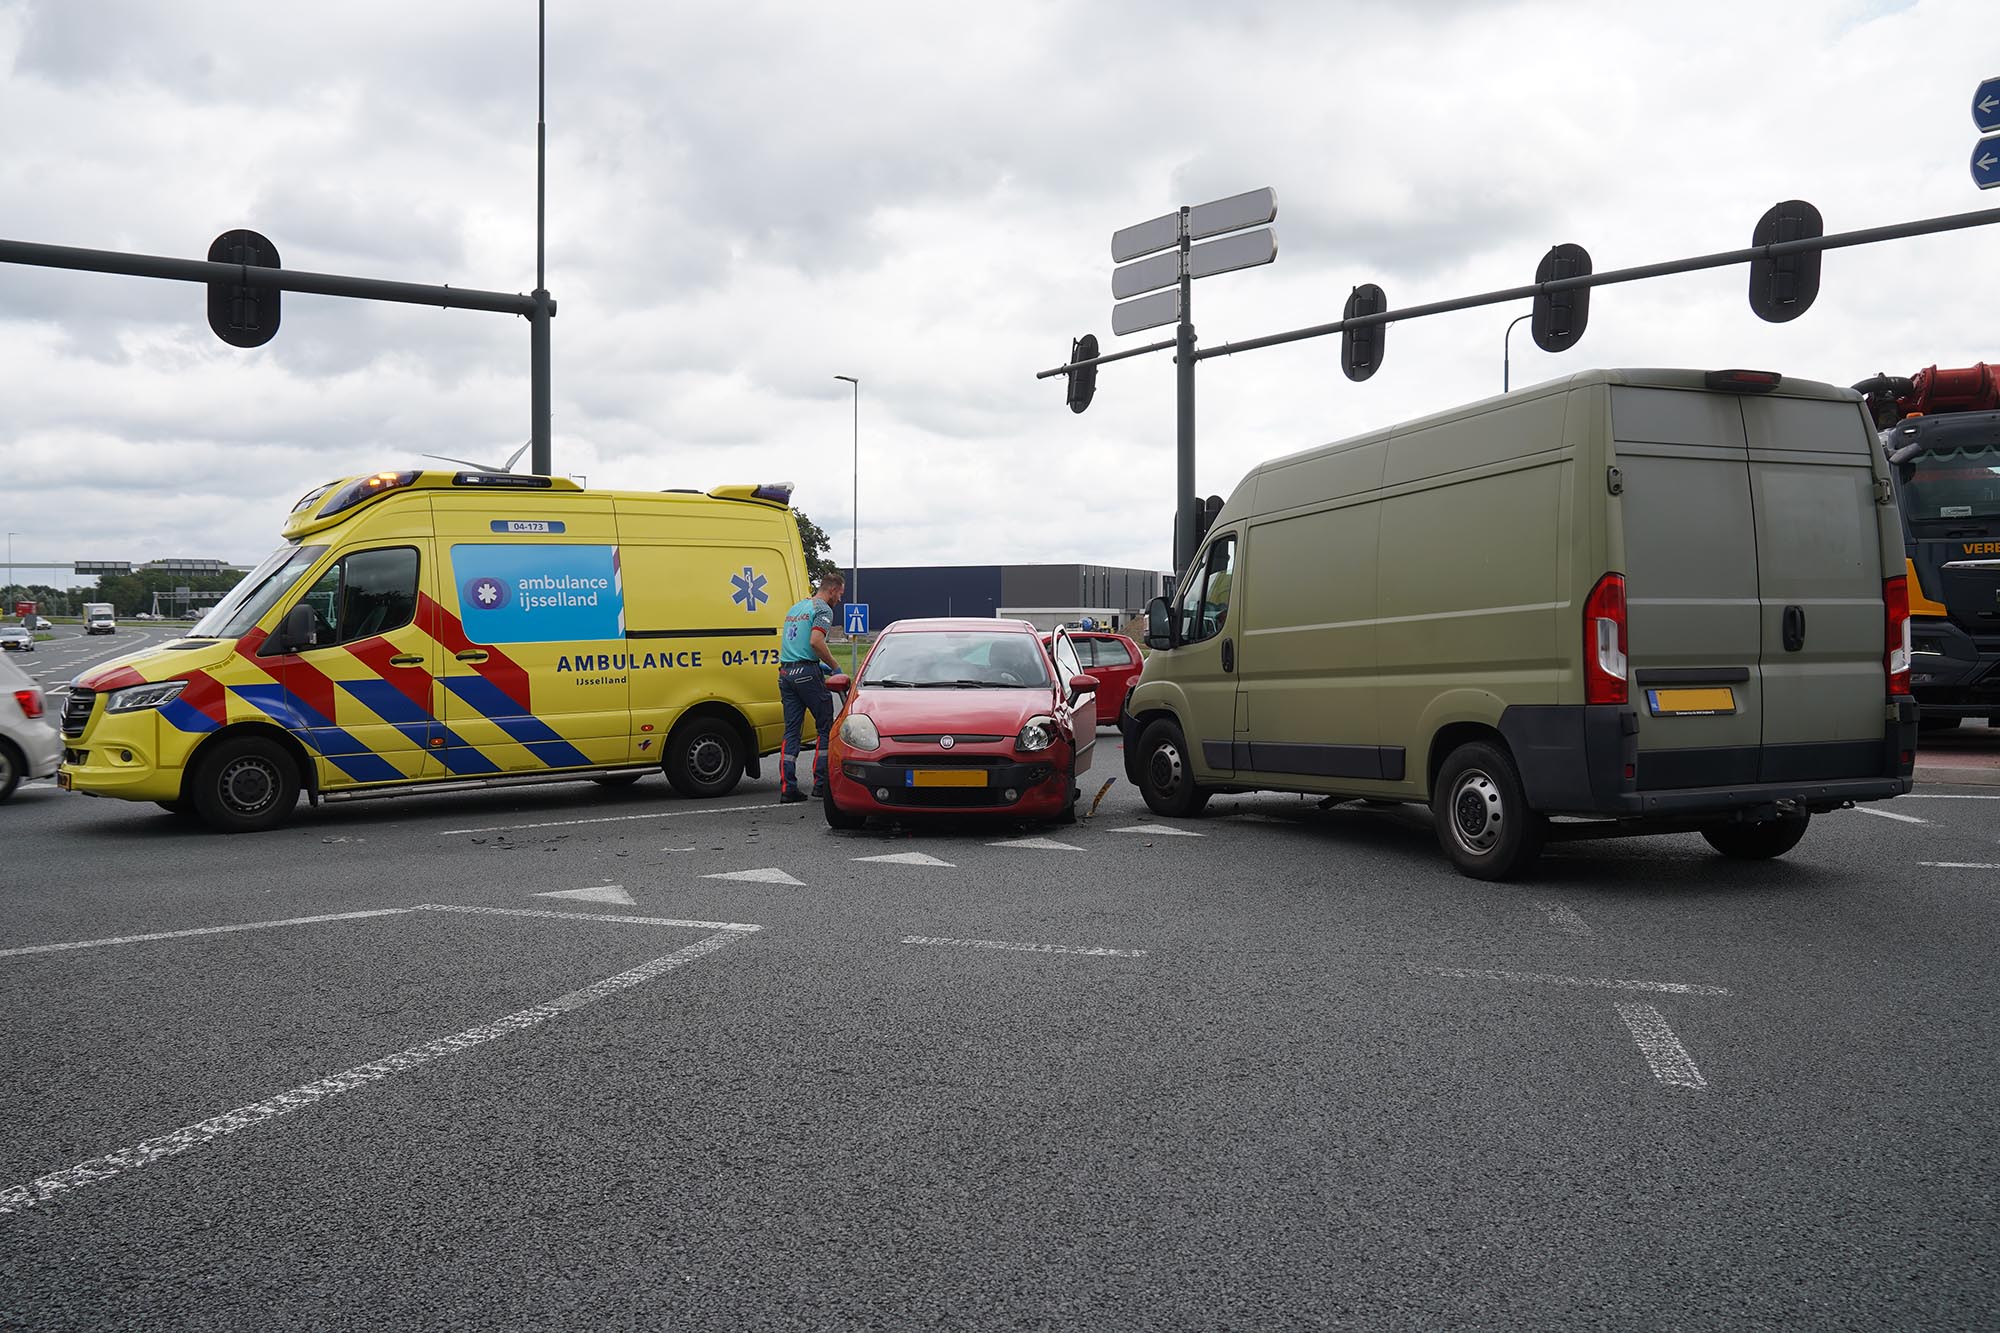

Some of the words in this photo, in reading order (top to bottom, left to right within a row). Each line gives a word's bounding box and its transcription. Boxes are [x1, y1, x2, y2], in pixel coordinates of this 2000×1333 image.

[519, 575, 608, 589] ambulance
[520, 592, 598, 612] ijsselland
[557, 651, 702, 672] AMBULANCE
[722, 649, 780, 666] 04-173
[576, 676, 627, 686] IJsselland
